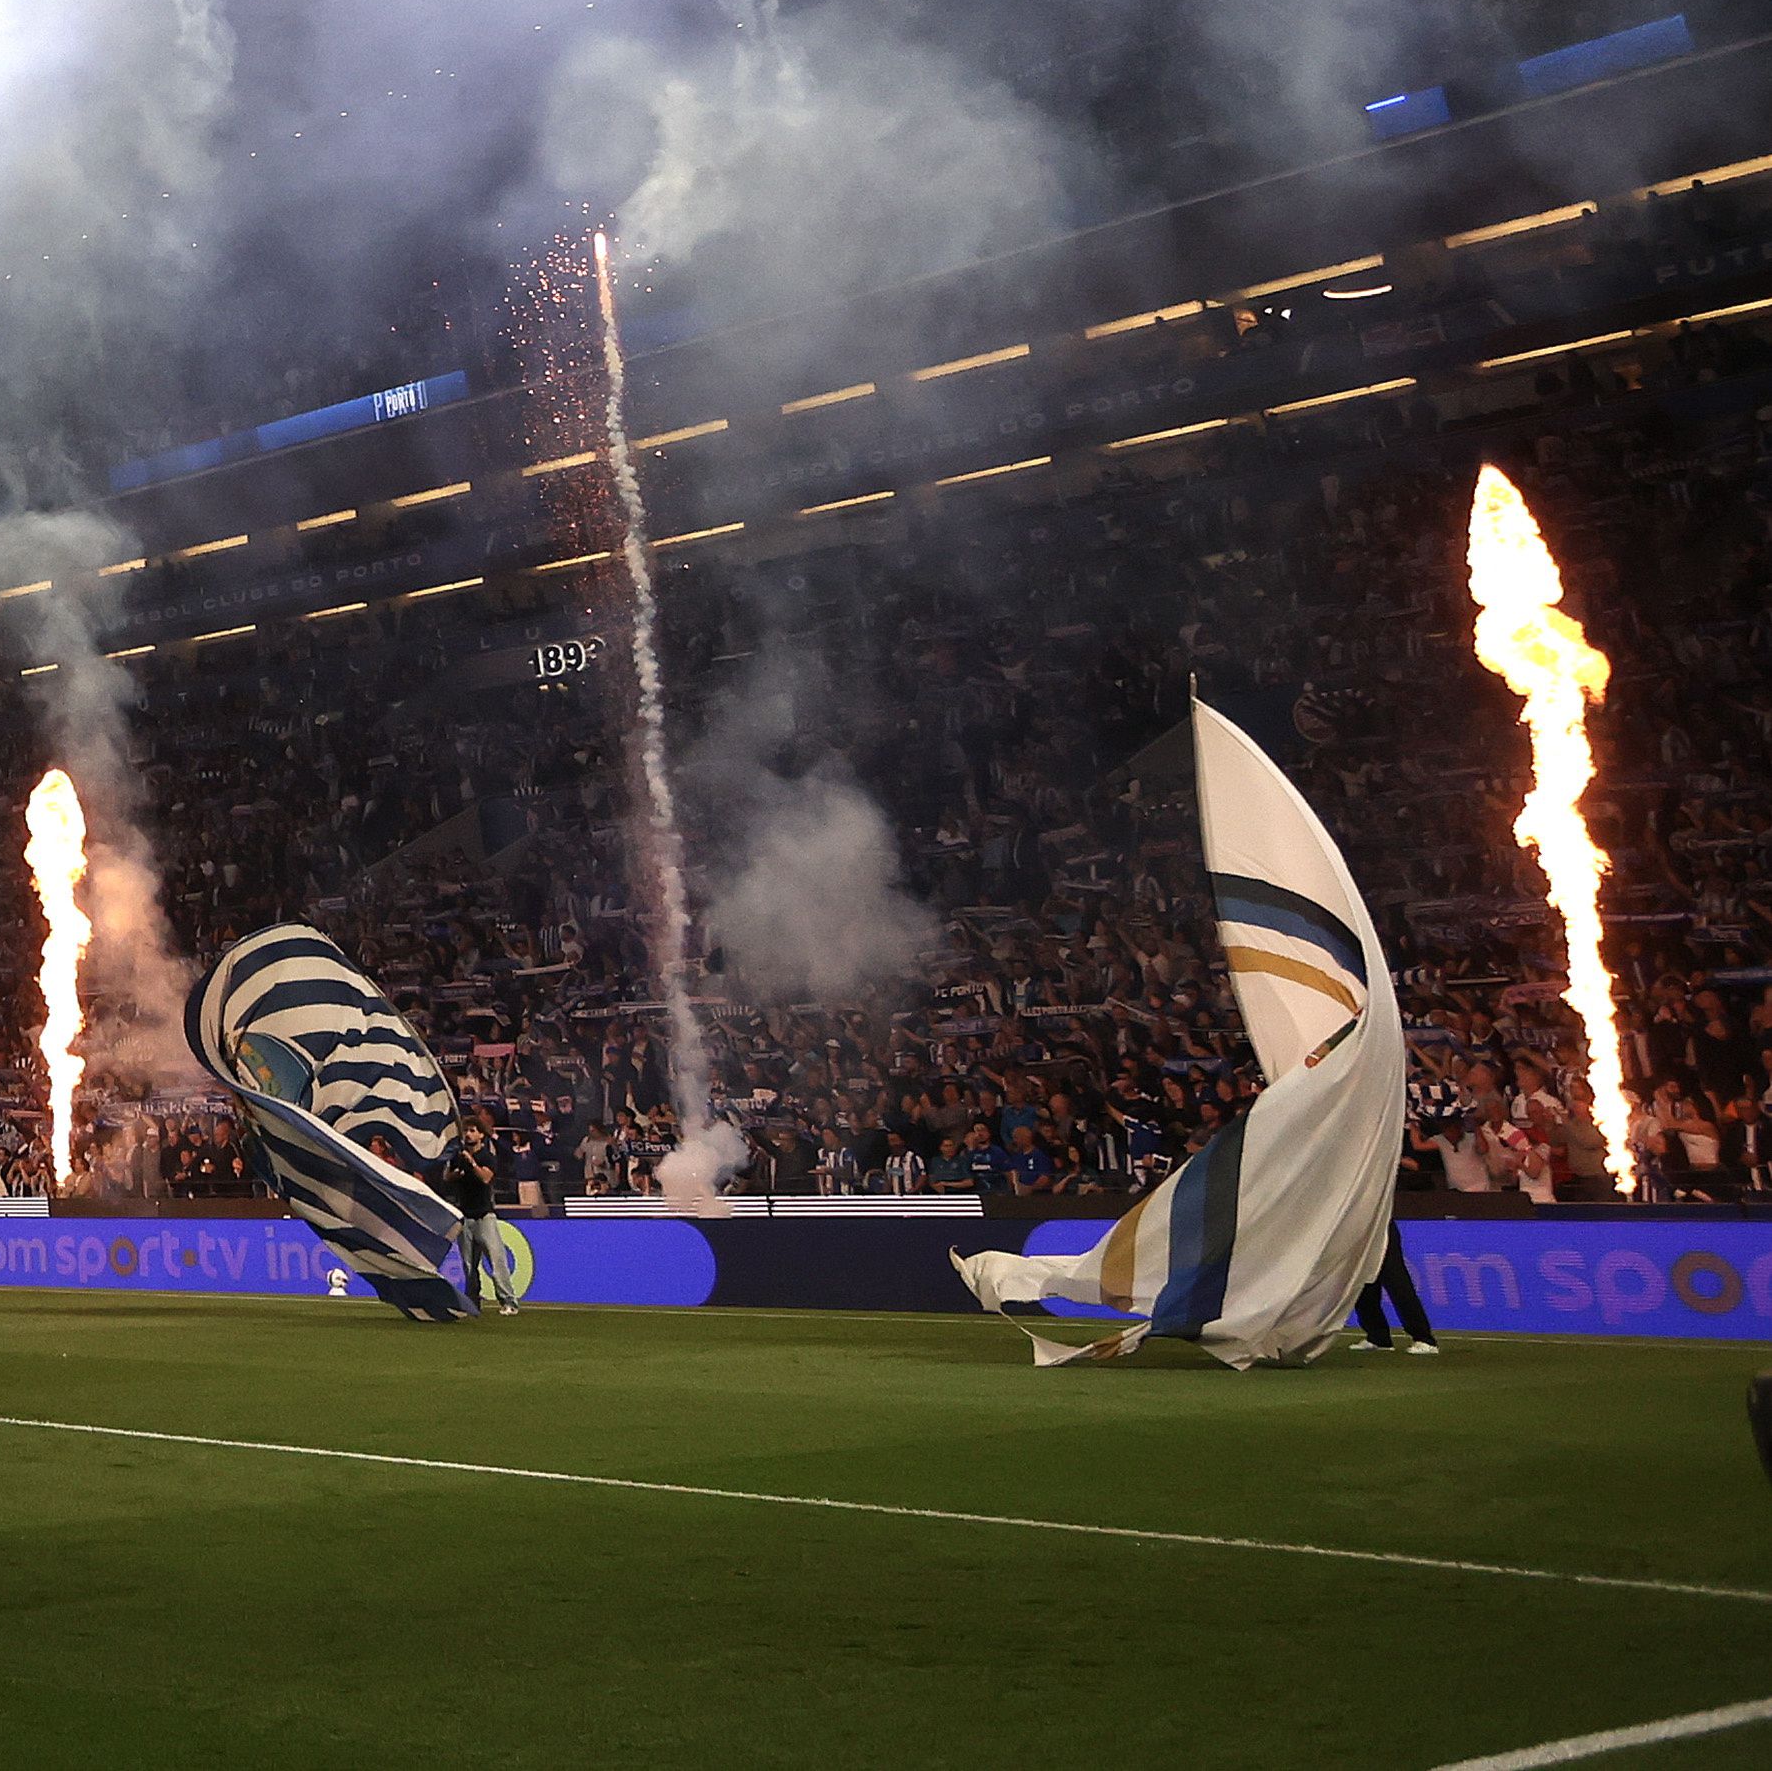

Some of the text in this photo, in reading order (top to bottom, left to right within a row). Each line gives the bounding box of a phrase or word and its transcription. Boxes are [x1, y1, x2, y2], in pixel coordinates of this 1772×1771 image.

[1066, 377, 1196, 418] PORTO
[202, 583, 280, 611] CLUBE
[335, 553, 423, 583] PORTO
